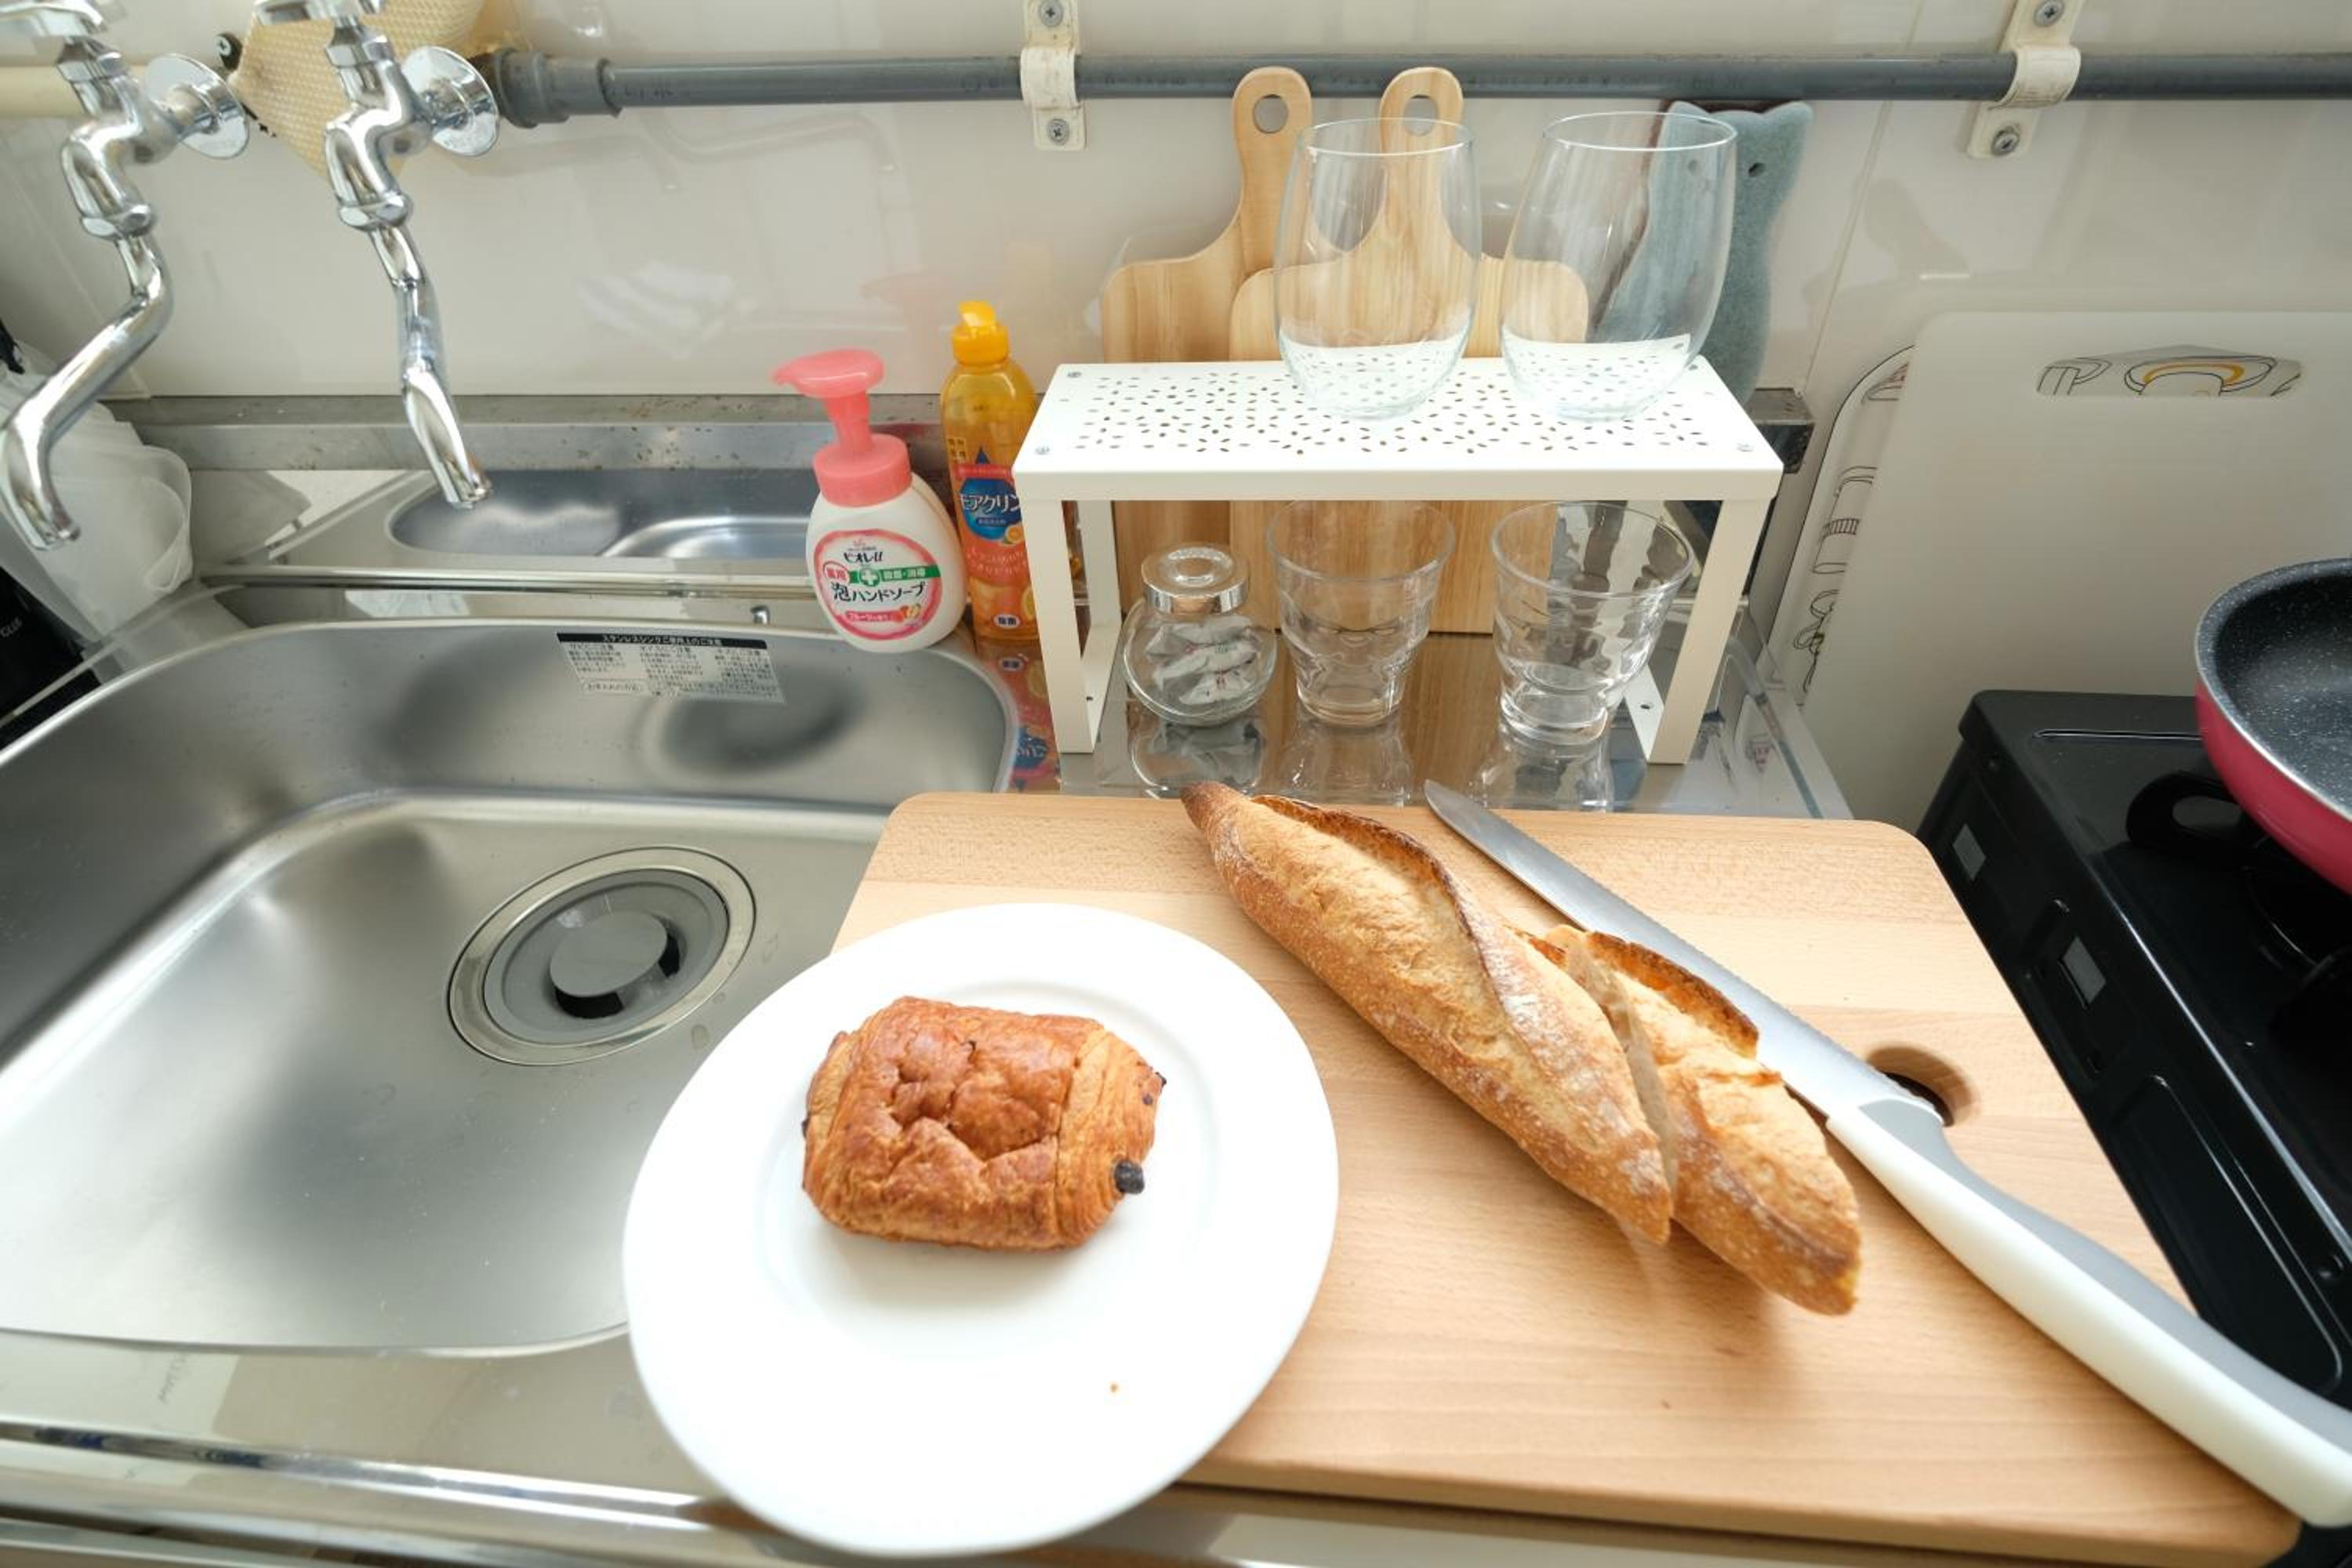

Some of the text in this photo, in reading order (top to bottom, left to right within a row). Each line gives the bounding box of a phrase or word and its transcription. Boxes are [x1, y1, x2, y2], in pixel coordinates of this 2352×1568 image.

[831, 582, 925, 602] 泡ハンドソープ
